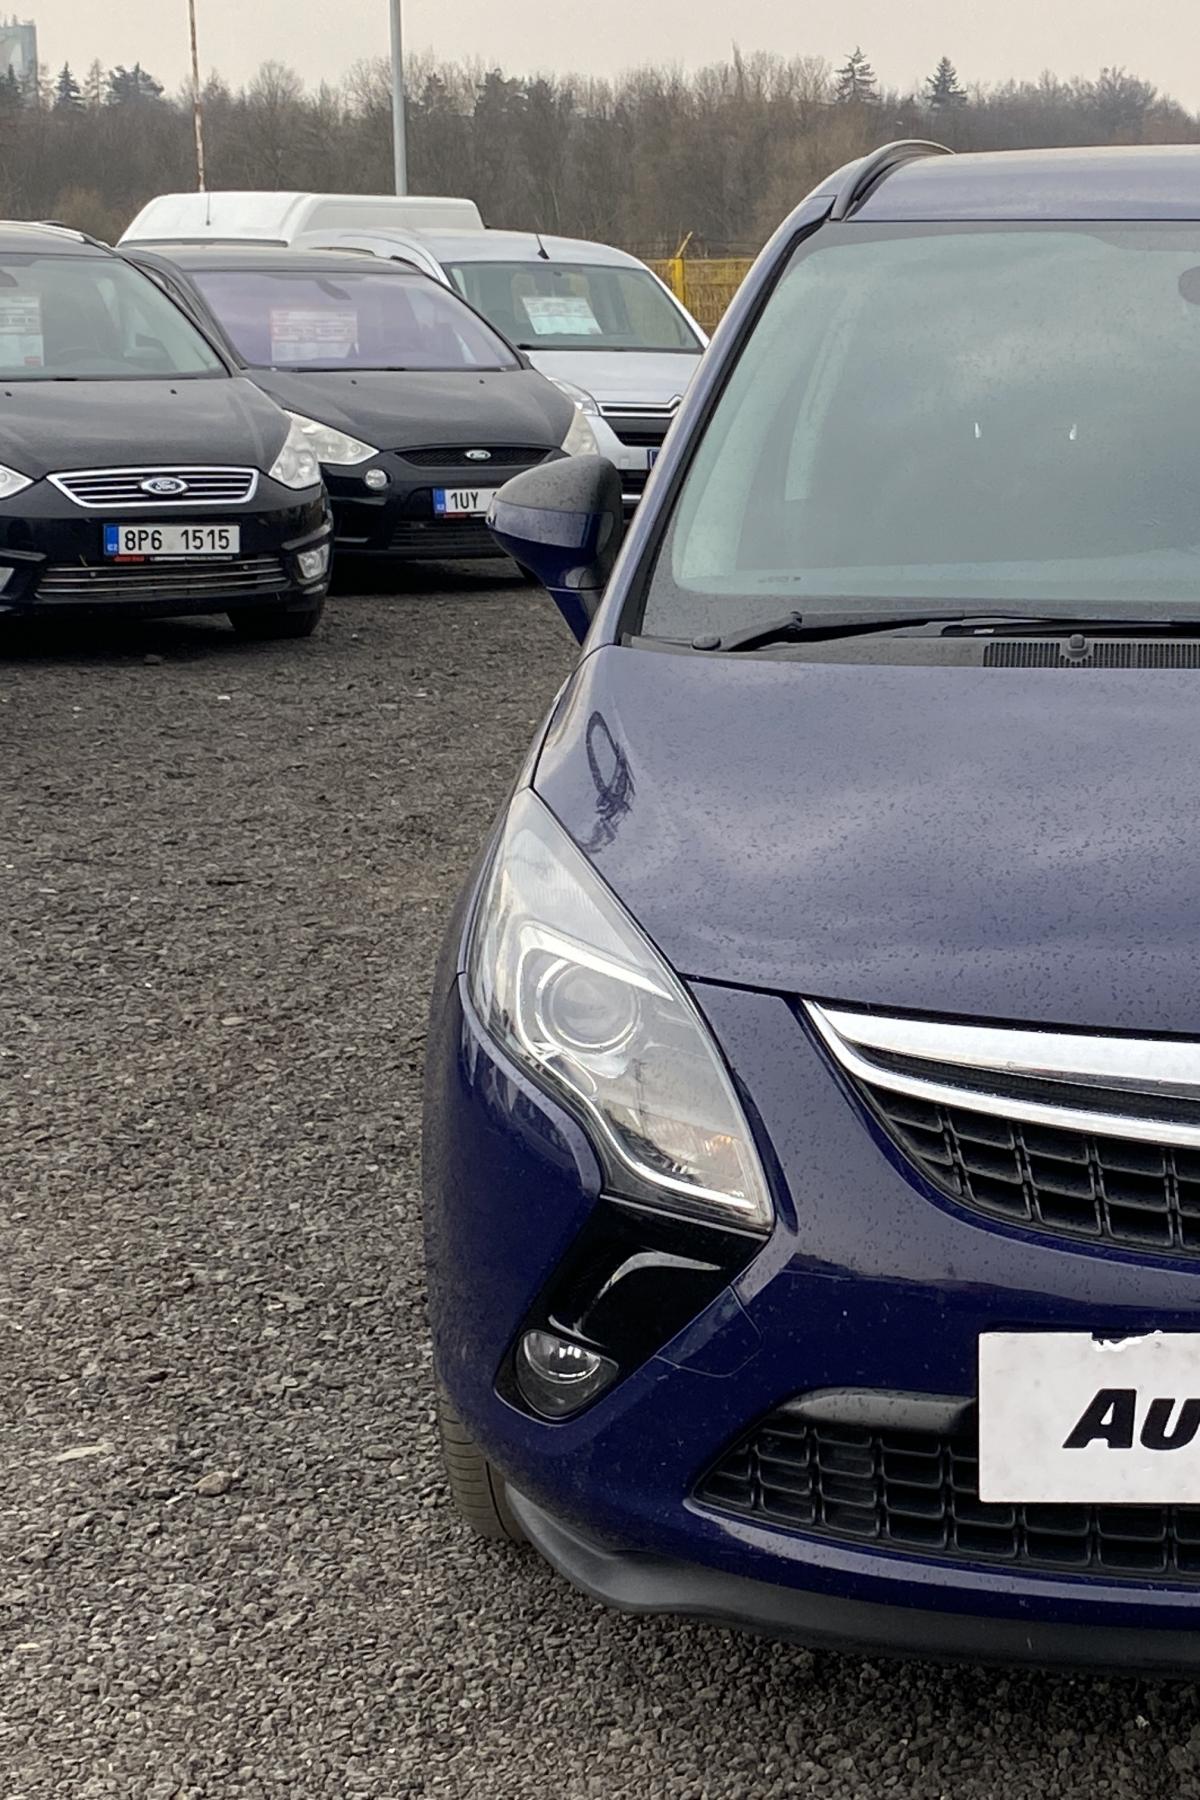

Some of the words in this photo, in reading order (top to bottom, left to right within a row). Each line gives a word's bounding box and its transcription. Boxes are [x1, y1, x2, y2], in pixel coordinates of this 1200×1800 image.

[450, 491, 479, 510] 1UY
[124, 529, 163, 552] 8P6
[180, 528, 230, 551] 1515
